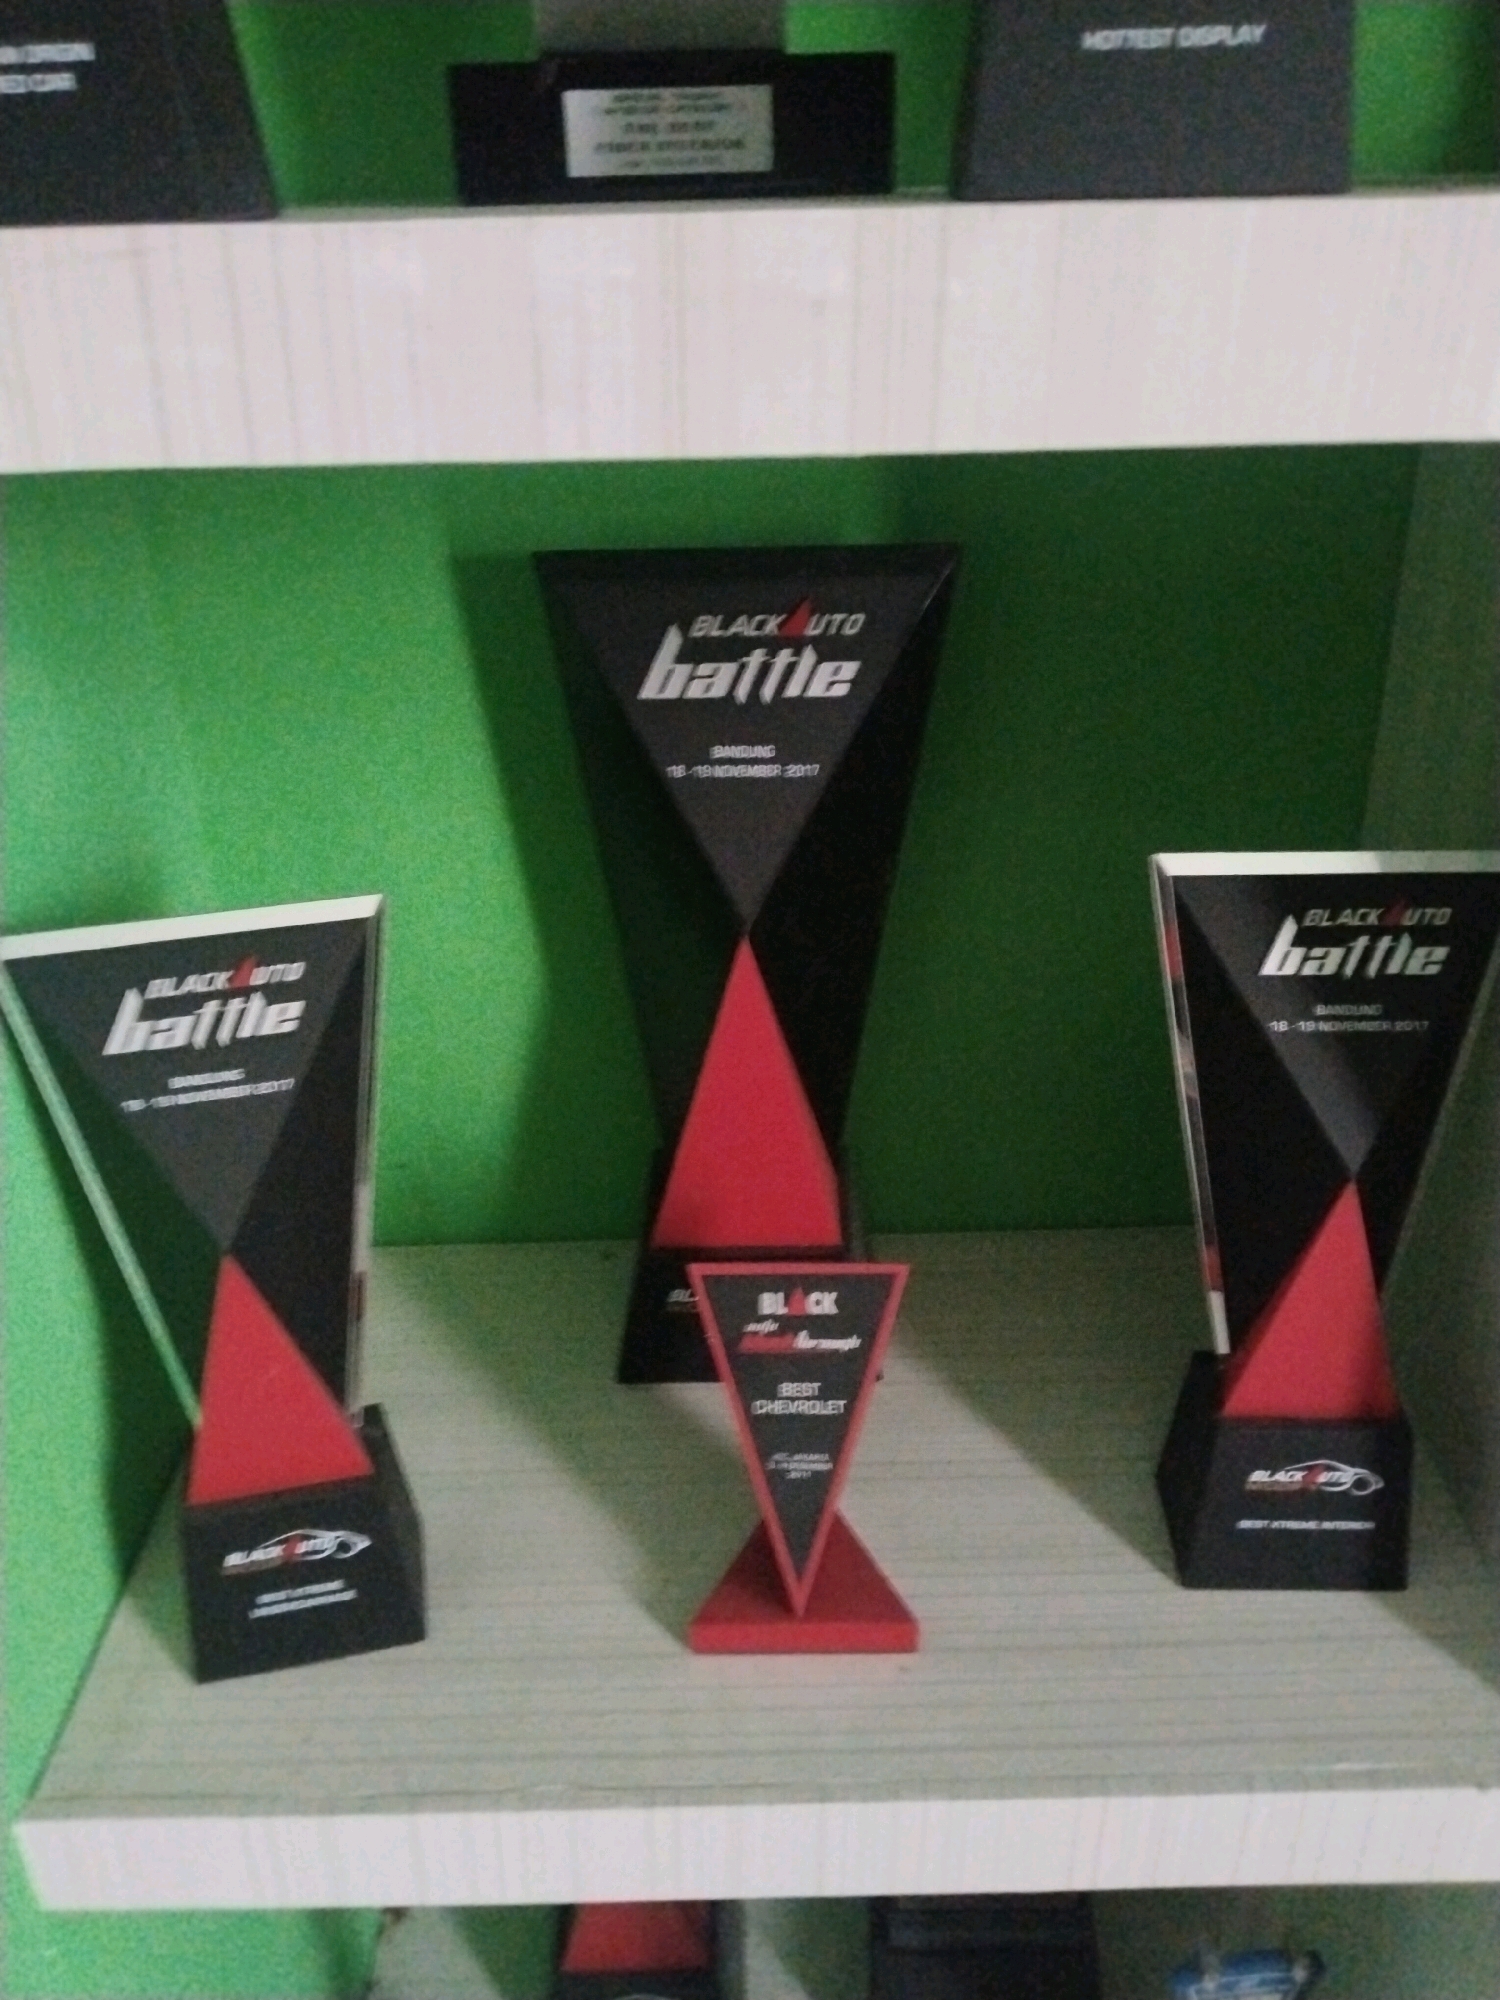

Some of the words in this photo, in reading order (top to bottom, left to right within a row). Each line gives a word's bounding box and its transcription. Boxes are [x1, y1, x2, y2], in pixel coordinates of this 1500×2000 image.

[1081, 27, 1175, 50] HOTTEST
[1177, 24, 1267, 48] DISPLAY
[637, 622, 862, 705] battle
[709, 745, 776, 759] BANDUNG
[713, 764, 782, 778] NOVEMBER
[783, 764, 820, 778] 2017
[1257, 914, 1450, 979] battle
[1314, 1004, 1383, 1016] BANDUNG
[102, 987, 306, 1056] battle
[1318, 1020, 1394, 1032] NOVEMBER
[777, 1382, 821, 1397] BEST
[752, 1400, 847, 1415] CHEVROLET
